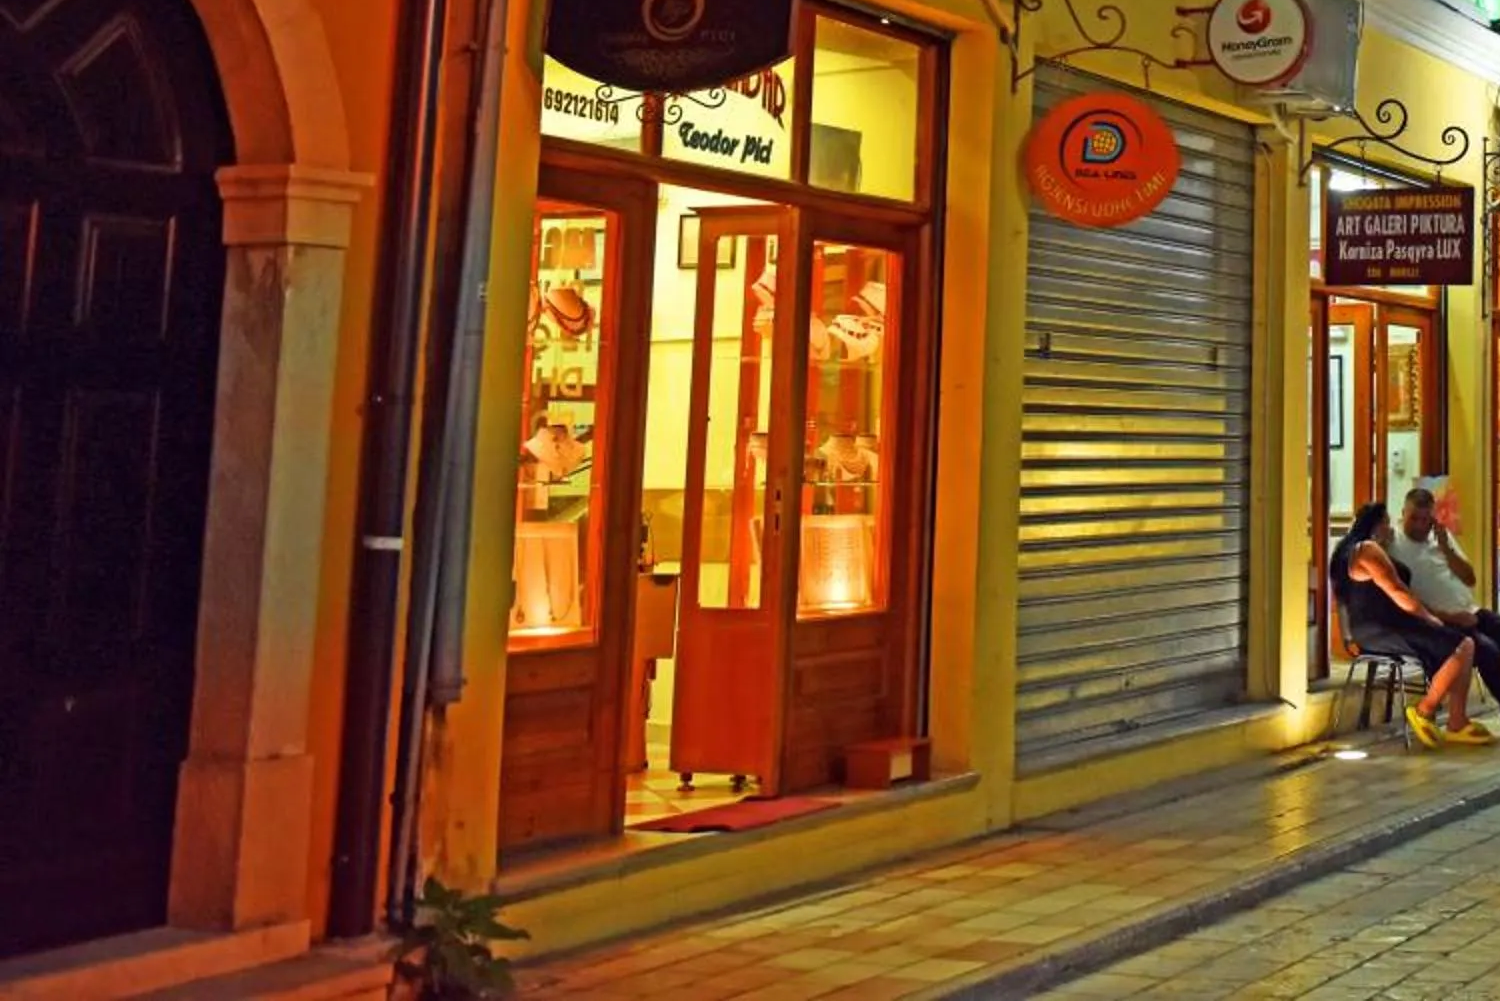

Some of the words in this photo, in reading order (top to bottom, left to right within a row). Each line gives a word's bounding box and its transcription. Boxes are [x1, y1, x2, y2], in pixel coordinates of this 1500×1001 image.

[678, 120, 741, 157] Teodor
[1335, 215, 1361, 236] ART
[1364, 215, 1407, 235] GALERI
[1410, 213, 1466, 235] PIKTURA
[1437, 237, 1462, 259] LUX
